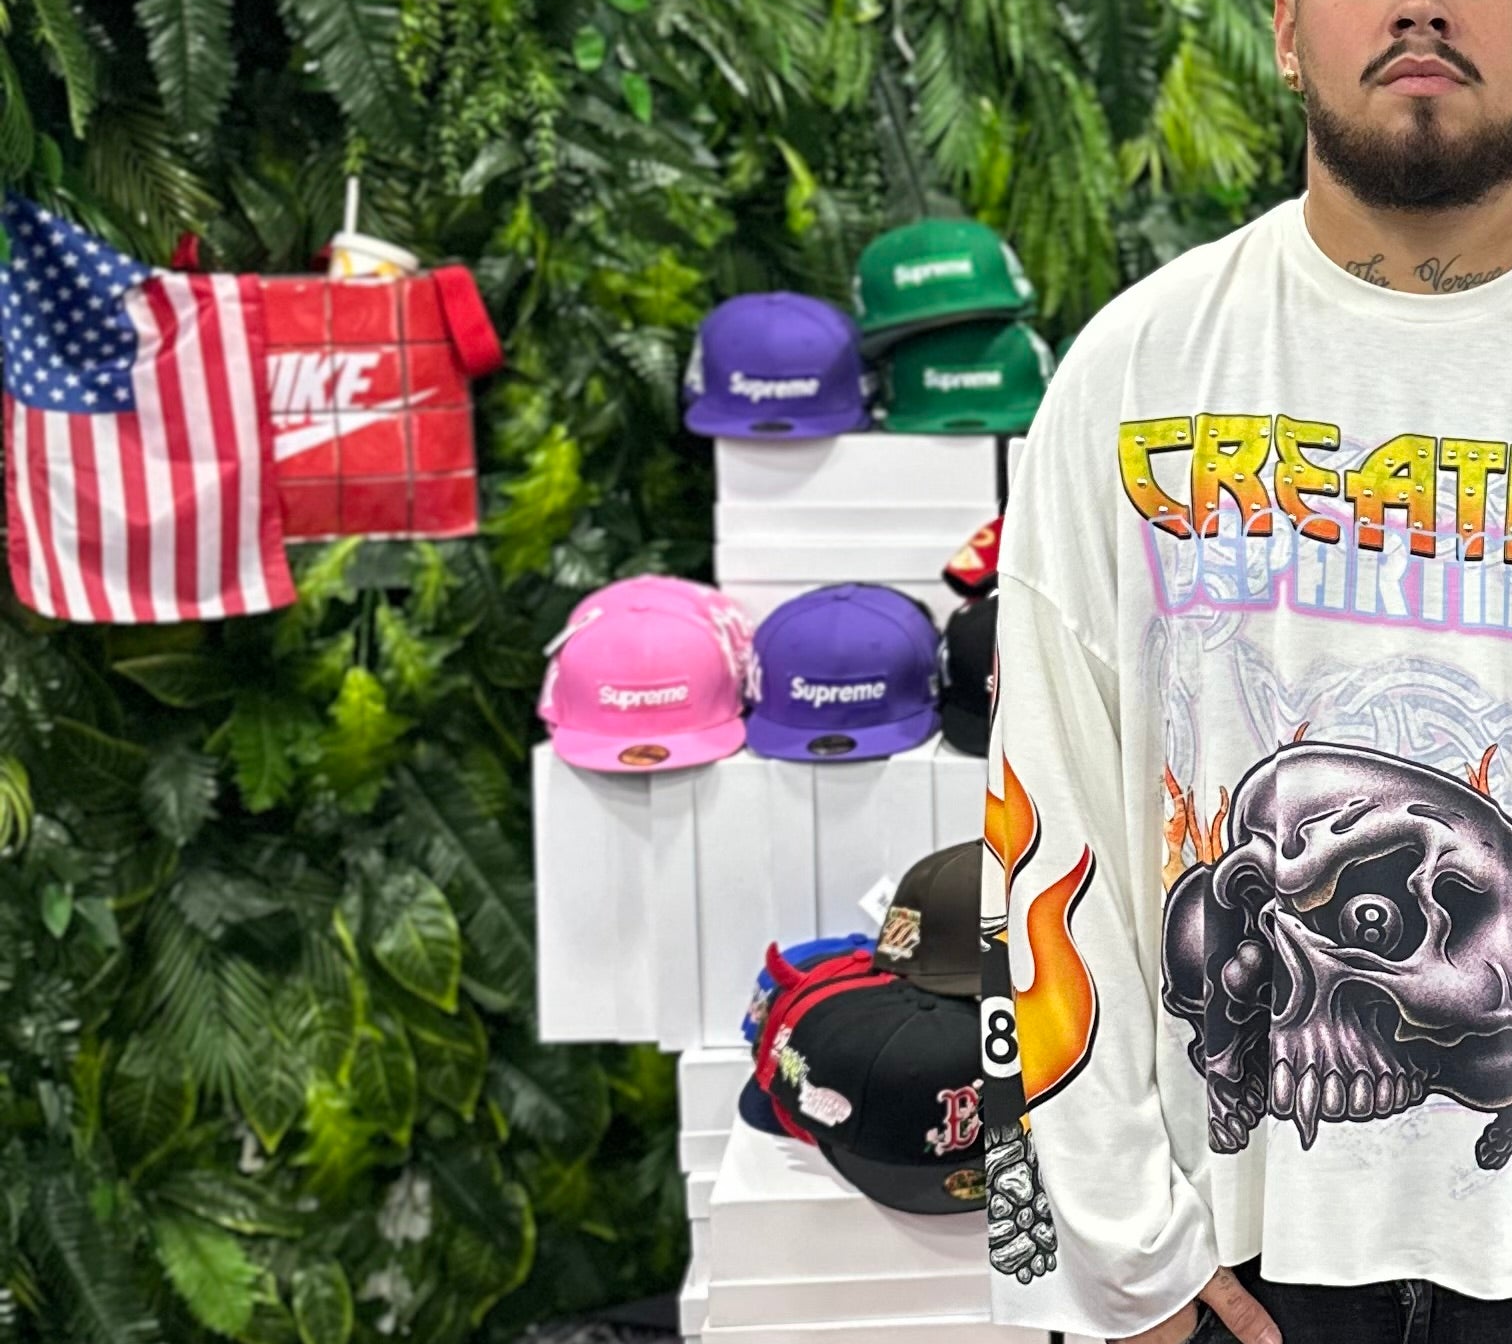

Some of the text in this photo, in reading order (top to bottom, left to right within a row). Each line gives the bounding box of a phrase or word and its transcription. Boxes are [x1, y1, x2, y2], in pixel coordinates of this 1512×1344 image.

[892, 258, 973, 288] Supreme
[729, 371, 821, 404] Supreme
[922, 367, 1004, 390] Supreme
[599, 684, 688, 712] Supreme
[790, 675, 887, 709] Supreme
[984, 1009, 1018, 1065] 8
